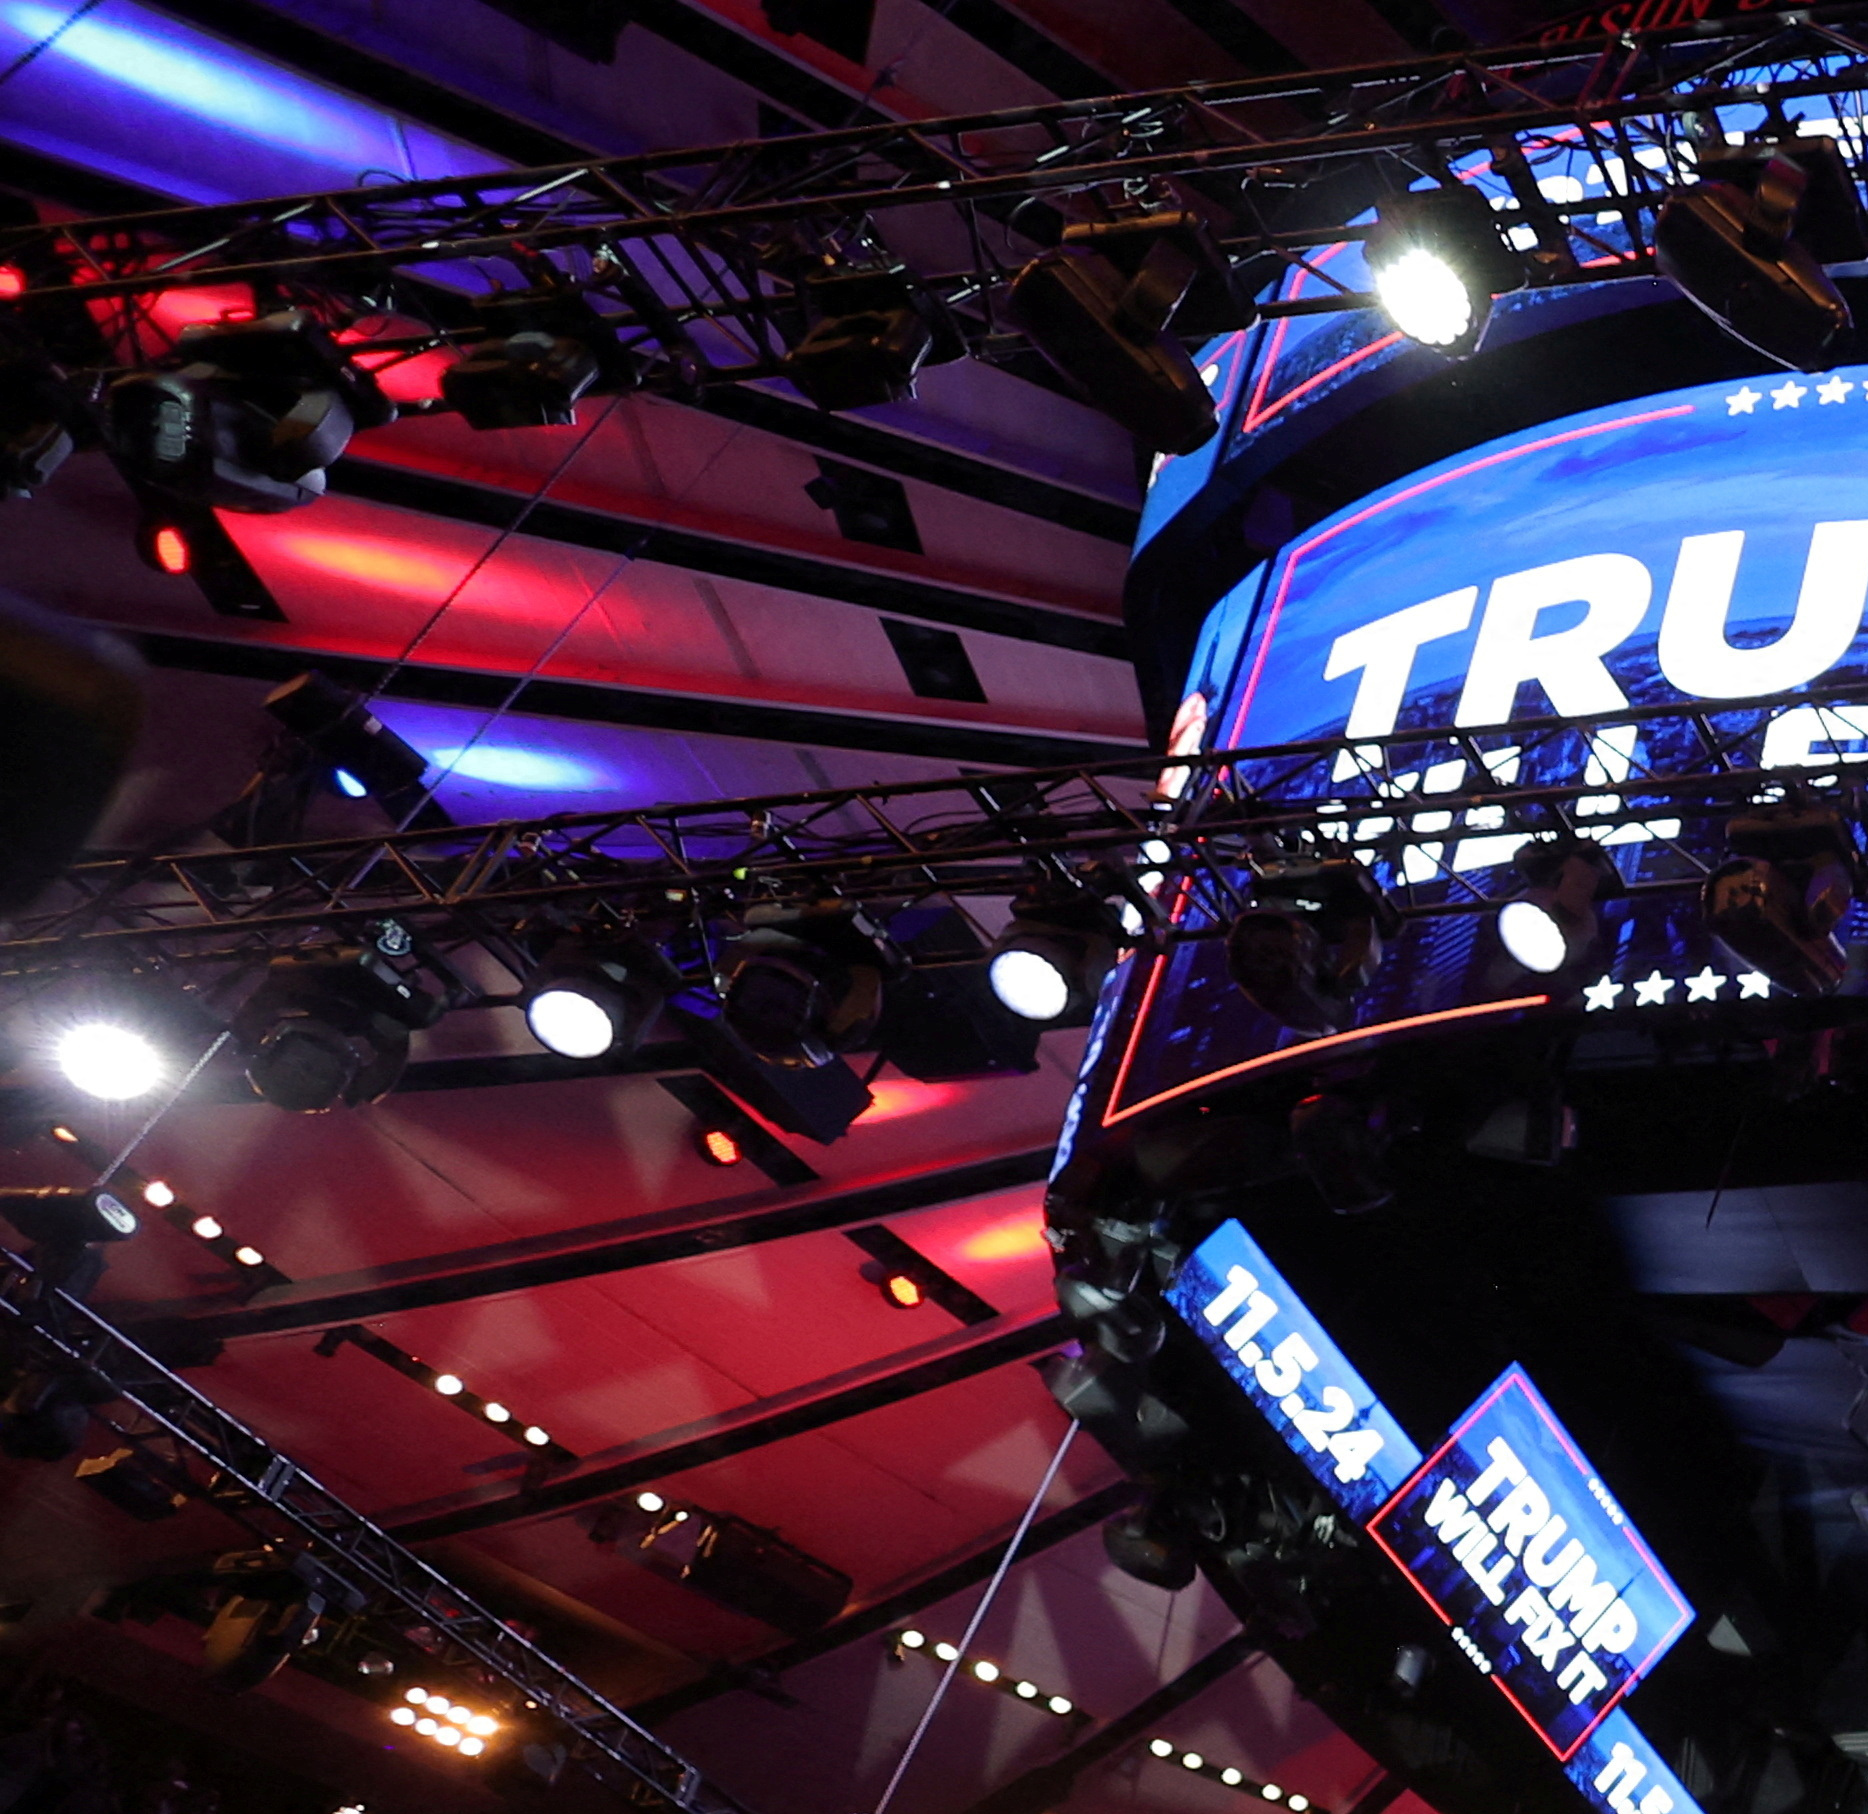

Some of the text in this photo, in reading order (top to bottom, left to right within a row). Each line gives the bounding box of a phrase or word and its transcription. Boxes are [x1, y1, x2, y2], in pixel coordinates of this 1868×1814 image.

[1202, 1264, 1387, 1484] 11.5.24
[1422, 1479, 1607, 1705] WILL FIX IT
[1465, 1437, 1639, 1656] TRUMP
